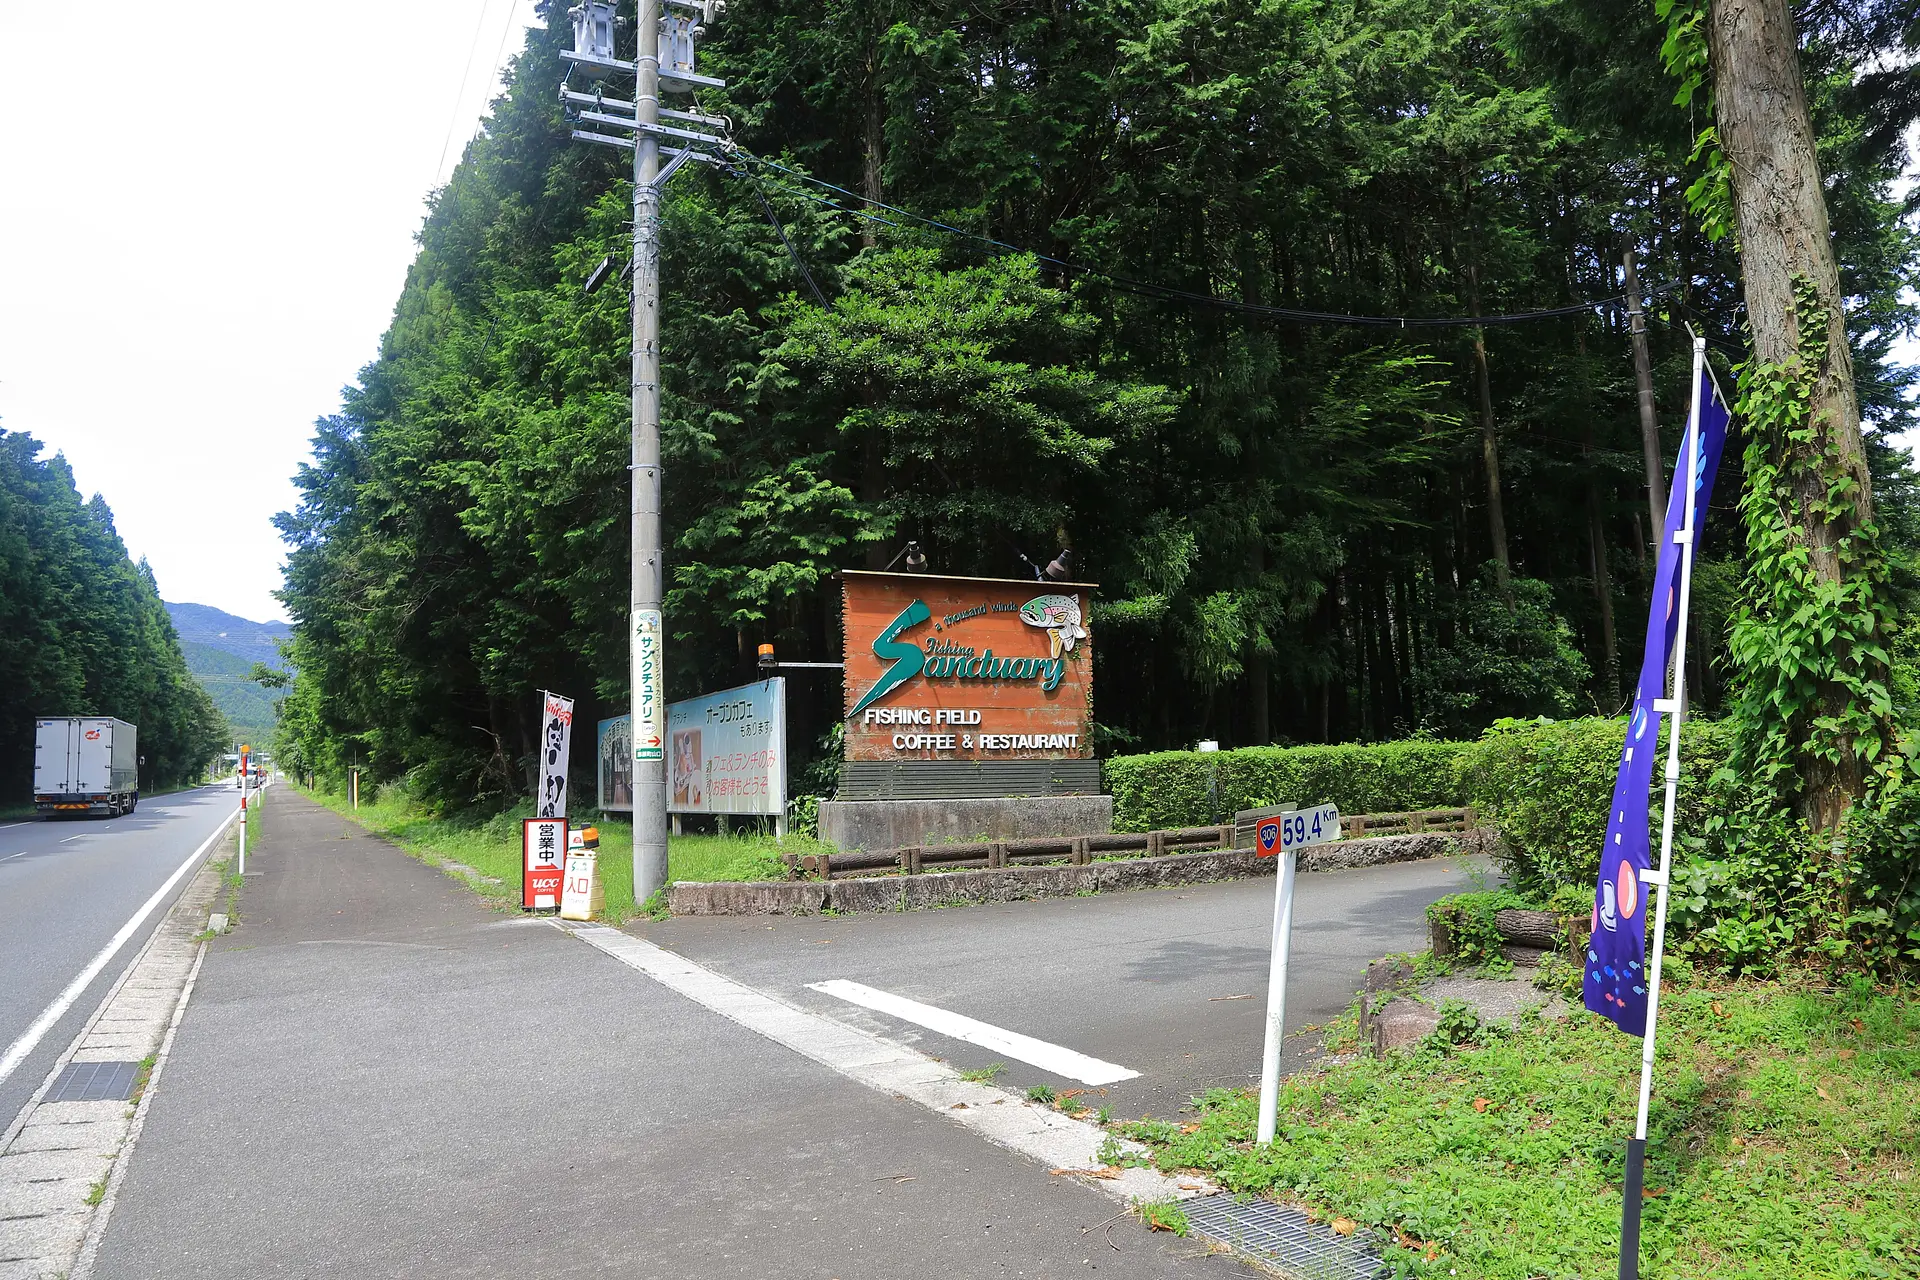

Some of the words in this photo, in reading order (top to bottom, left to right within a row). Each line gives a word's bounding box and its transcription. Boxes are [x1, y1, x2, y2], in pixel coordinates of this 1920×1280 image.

[943, 603, 987, 626] thousand
[990, 600, 1018, 613] winds
[923, 636, 974, 659] Fishing
[641, 636, 654, 719] サンクチュアリ
[706, 700, 753, 725] オープンカフェ
[864, 708, 931, 725] FISHING
[936, 709, 981, 725] FIELD
[892, 734, 956, 750] COFFEE
[962, 735, 974, 749] &
[979, 734, 1079, 750] RESTAURANT
[1262, 826, 1276, 841] 306
[1283, 811, 1322, 846] 59.4
[1323, 808, 1337, 822] Km
[538, 823, 555, 863] 営業中
[566, 876, 589, 894] 入口
